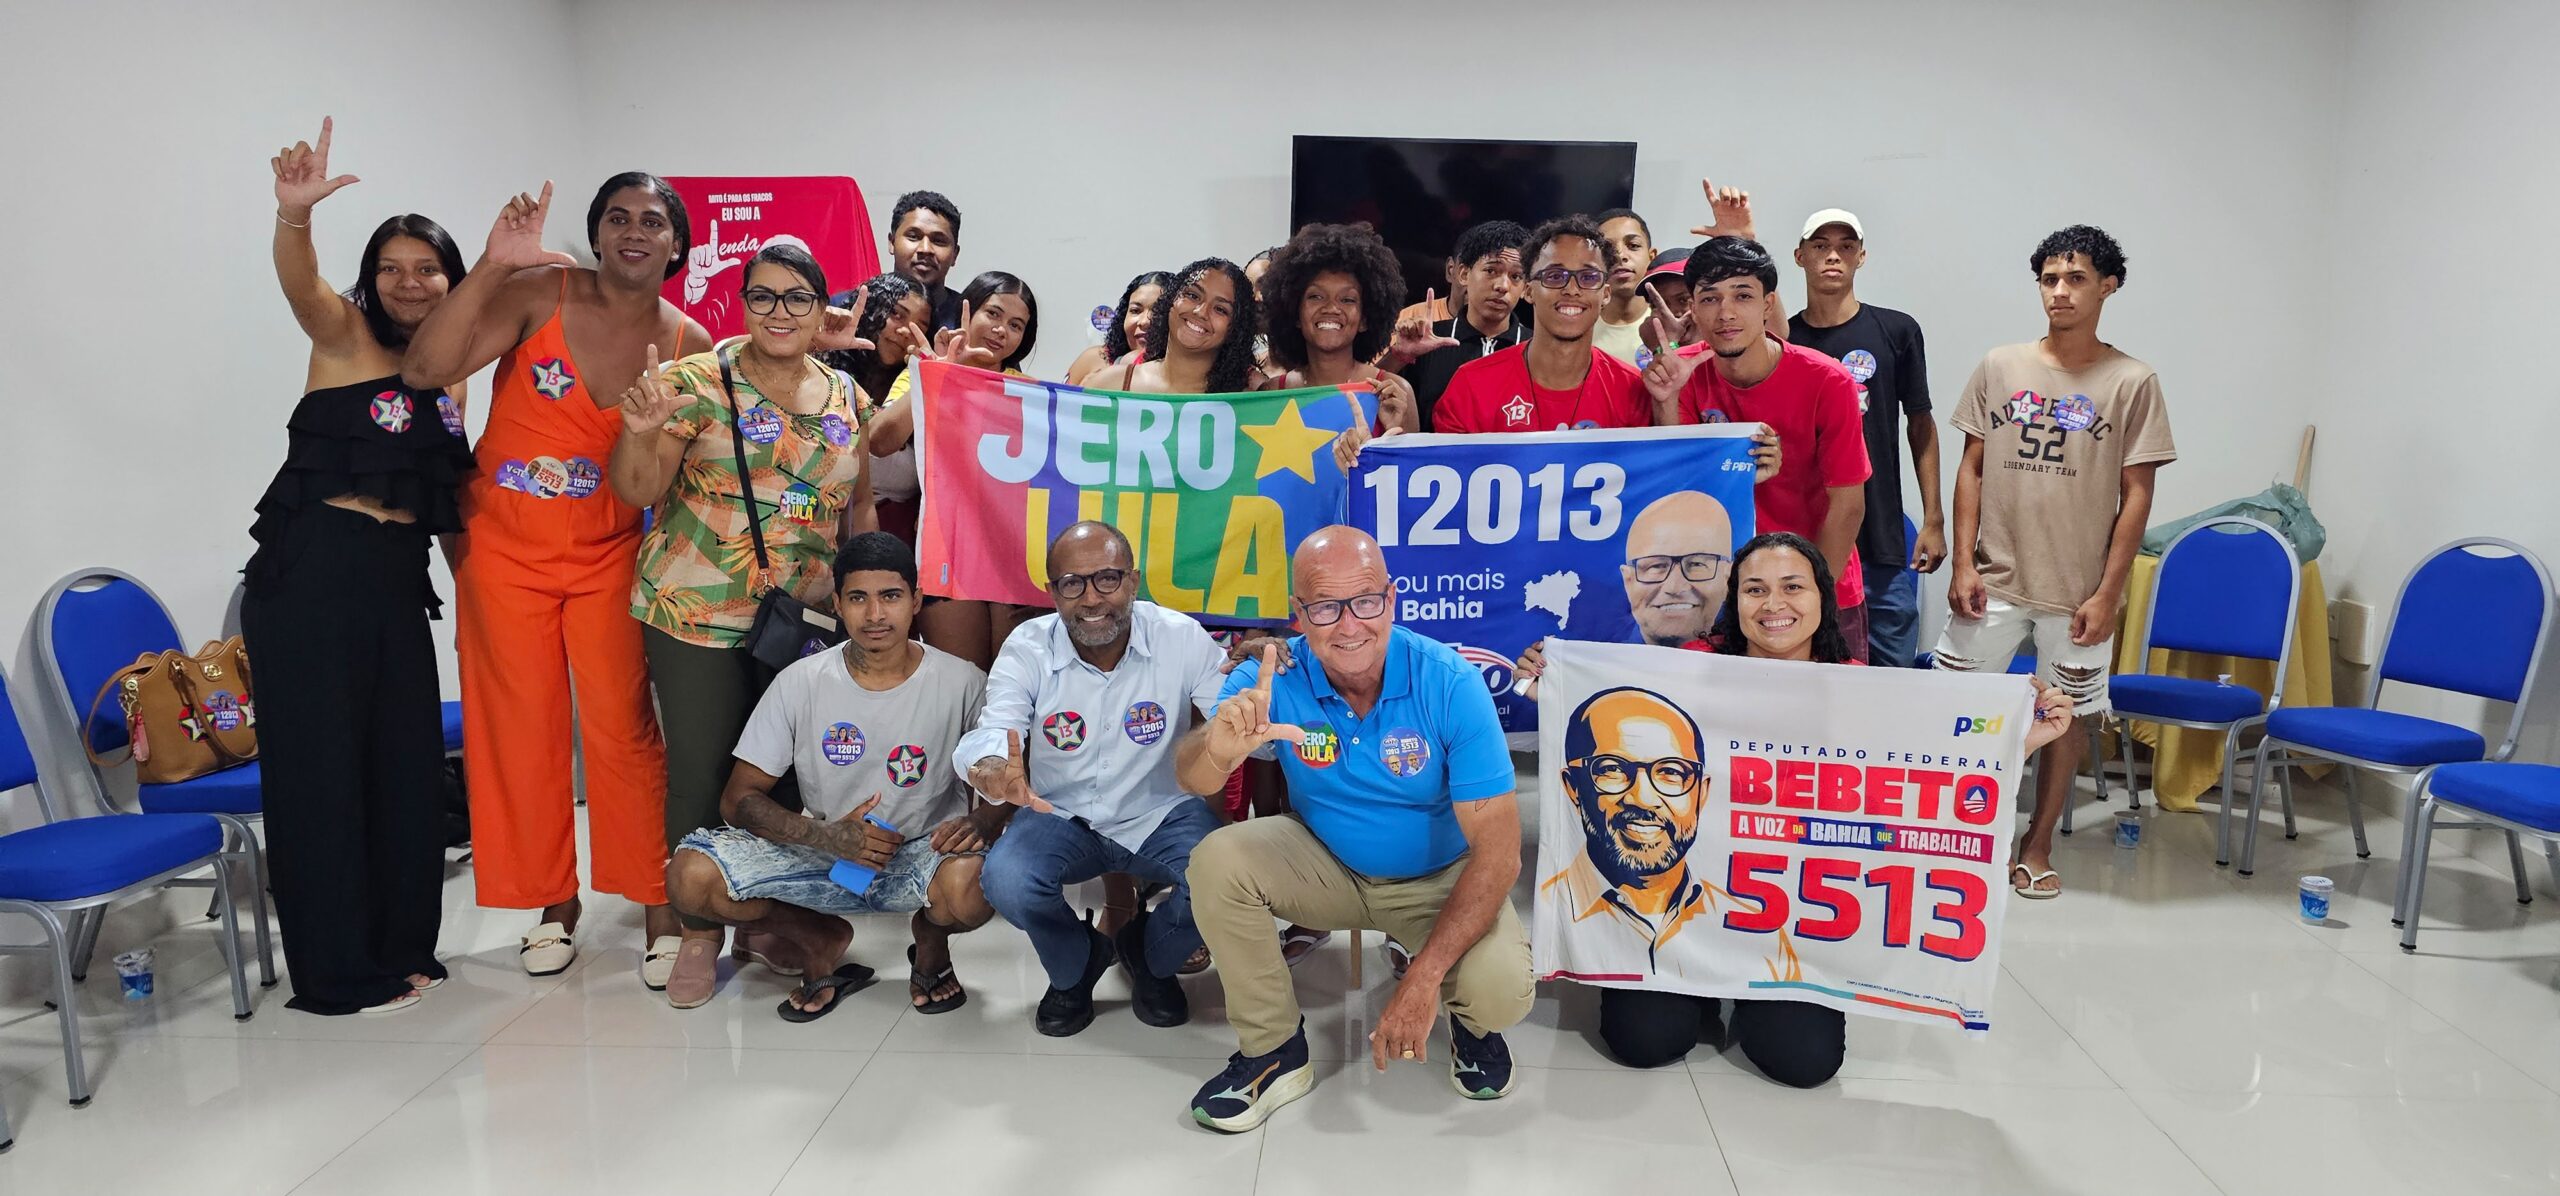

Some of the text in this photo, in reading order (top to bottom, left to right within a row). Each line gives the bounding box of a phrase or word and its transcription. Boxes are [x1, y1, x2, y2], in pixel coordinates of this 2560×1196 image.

[721, 206, 761, 221] EU SOU A
[545, 370, 560, 386] 13
[1510, 404, 1526, 420] 13
[2019, 402, 2030, 414] 13
[756, 422, 779, 434] 12013
[977, 378, 1236, 491] JERO
[2018, 422, 2067, 463] 52
[1731, 461, 1754, 473] PDT
[2003, 460, 2078, 478] LEGENDARY TEAM
[535, 473, 562, 490] 5513
[573, 477, 596, 489] 12013
[781, 490, 809, 506] JERO
[1364, 463, 1626, 547] 12013
[784, 503, 813, 522] LULA
[1387, 567, 1505, 594] ou mais
[1402, 595, 1484, 621] Bahia
[1058, 725, 1073, 739] 13
[1141, 720, 1164, 734] 12013
[1953, 715, 2004, 737] psd
[836, 744, 861, 755] 12013
[1300, 744, 1336, 763] LULA
[1401, 741, 1420, 751] 5513
[1730, 740, 2003, 771] DEPUTADO FEDERAL
[899, 758, 915, 773] 13
[1730, 755, 1999, 826] BEBETO
[1738, 815, 1982, 858] A VOZ DA BAHIA QUE TRABALHA
[1723, 851, 1988, 962] 5513
